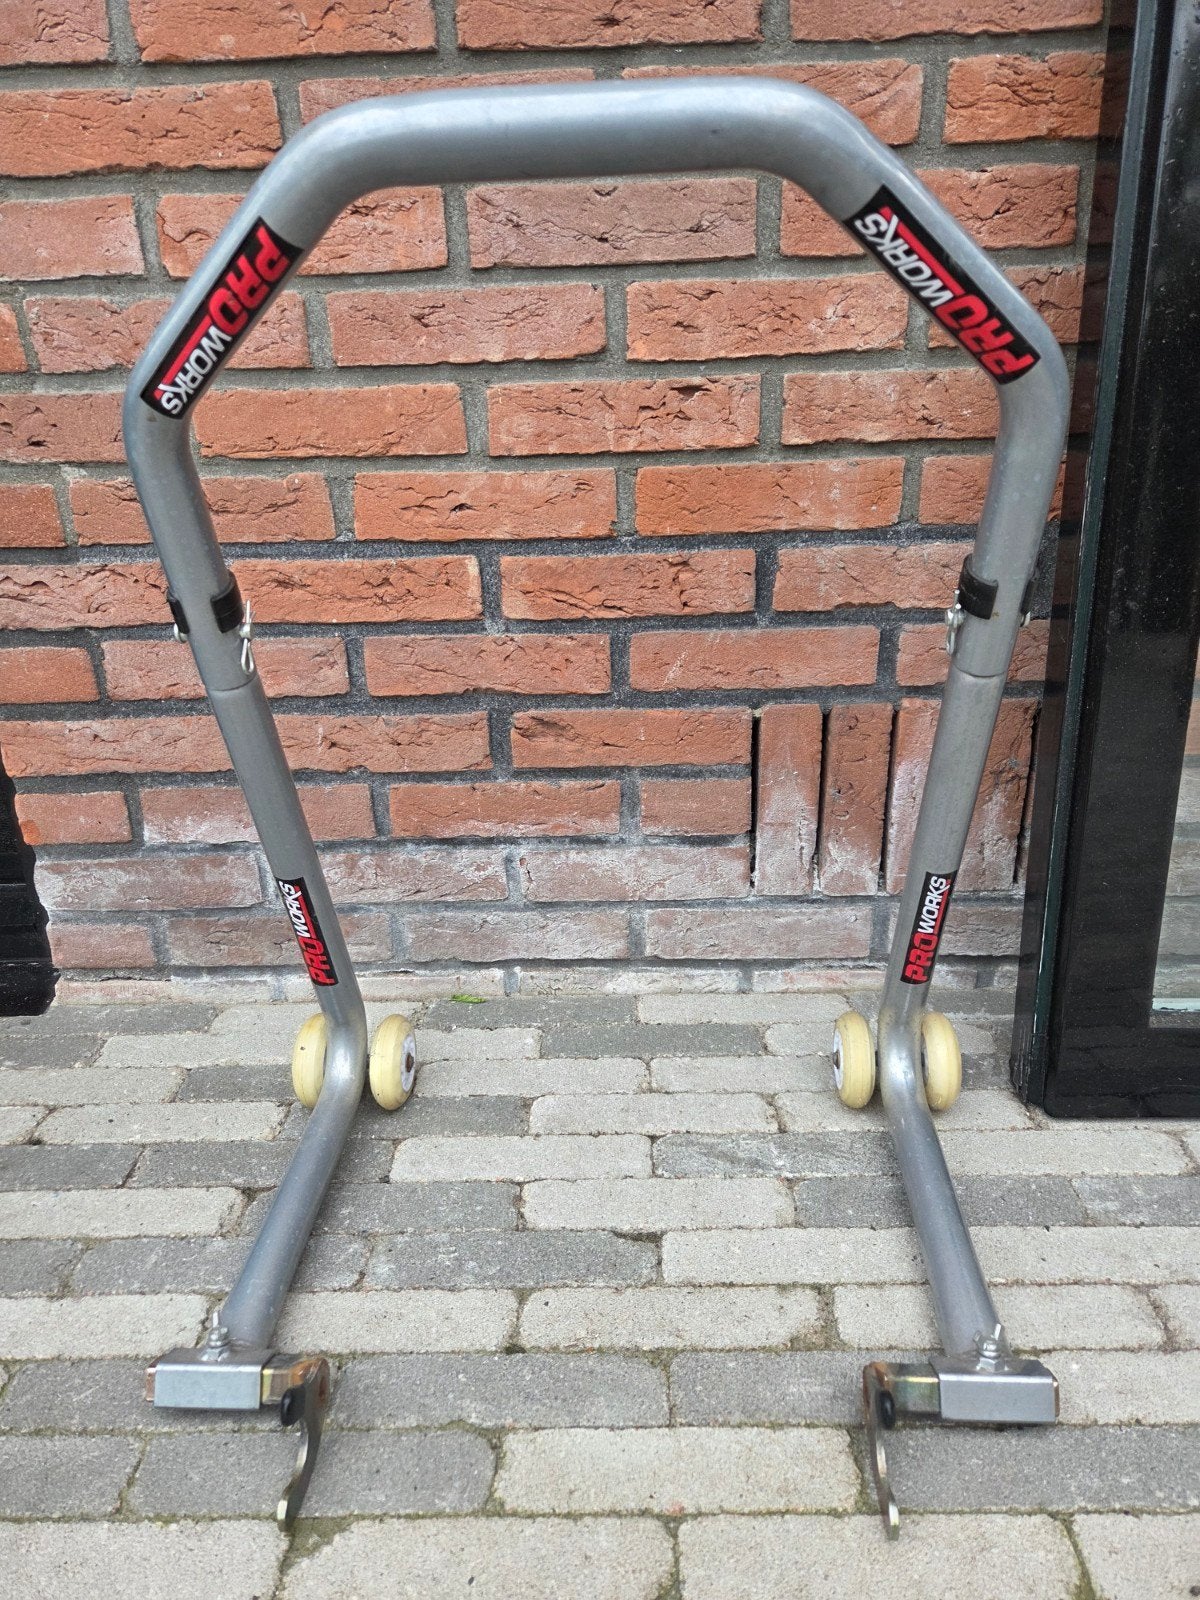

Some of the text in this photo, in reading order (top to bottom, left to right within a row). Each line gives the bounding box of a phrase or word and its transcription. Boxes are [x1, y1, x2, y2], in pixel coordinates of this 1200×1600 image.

[153, 225, 290, 415] PROWORKS
[853, 213, 1035, 375] PROWORKS
[278, 880, 336, 985] PROWORKS
[905, 875, 951, 982] PROWORKS
